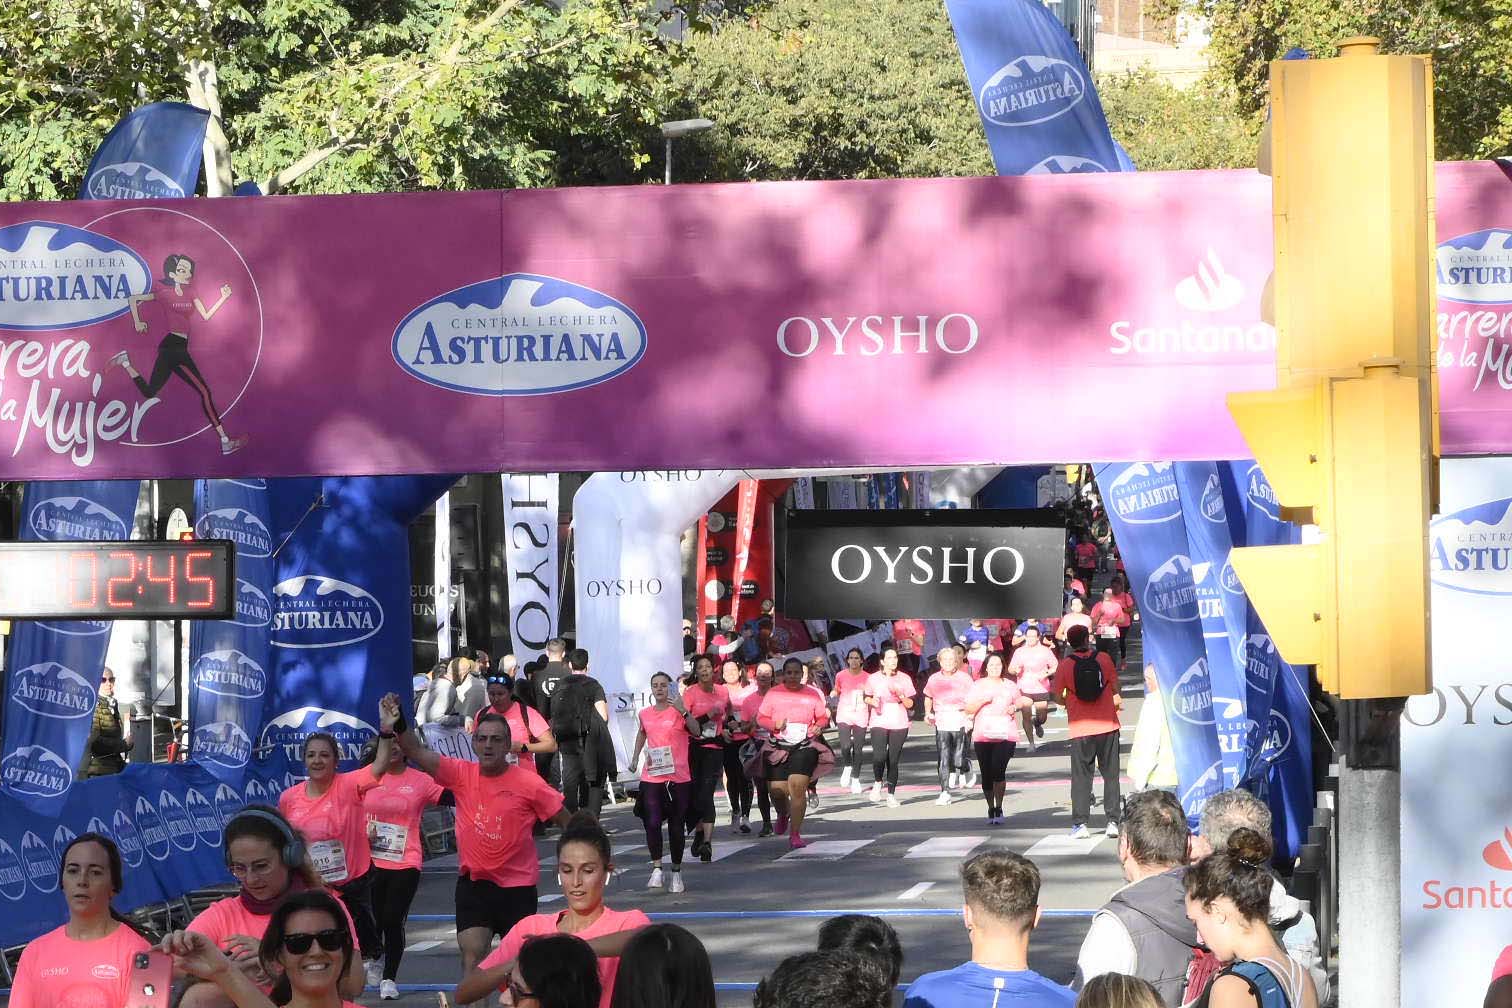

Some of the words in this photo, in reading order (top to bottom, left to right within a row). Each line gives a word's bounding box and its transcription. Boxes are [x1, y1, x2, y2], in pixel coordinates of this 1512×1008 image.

[54, 257, 127, 269] LECHERA
[450, 317, 529, 330] CENTRAL
[537, 313, 619, 328] LECHERA
[776, 313, 979, 358] OYSHO
[412, 321, 626, 366] ASTURIANA
[1460, 339, 1478, 368] la
[11, 373, 162, 467] Mujer
[830, 543, 1025, 586] OYSHO
[586, 577, 663, 599] OYSHO
[271, 610, 374, 631] STURIANA
[15, 677, 89, 711] ASTURIANA
